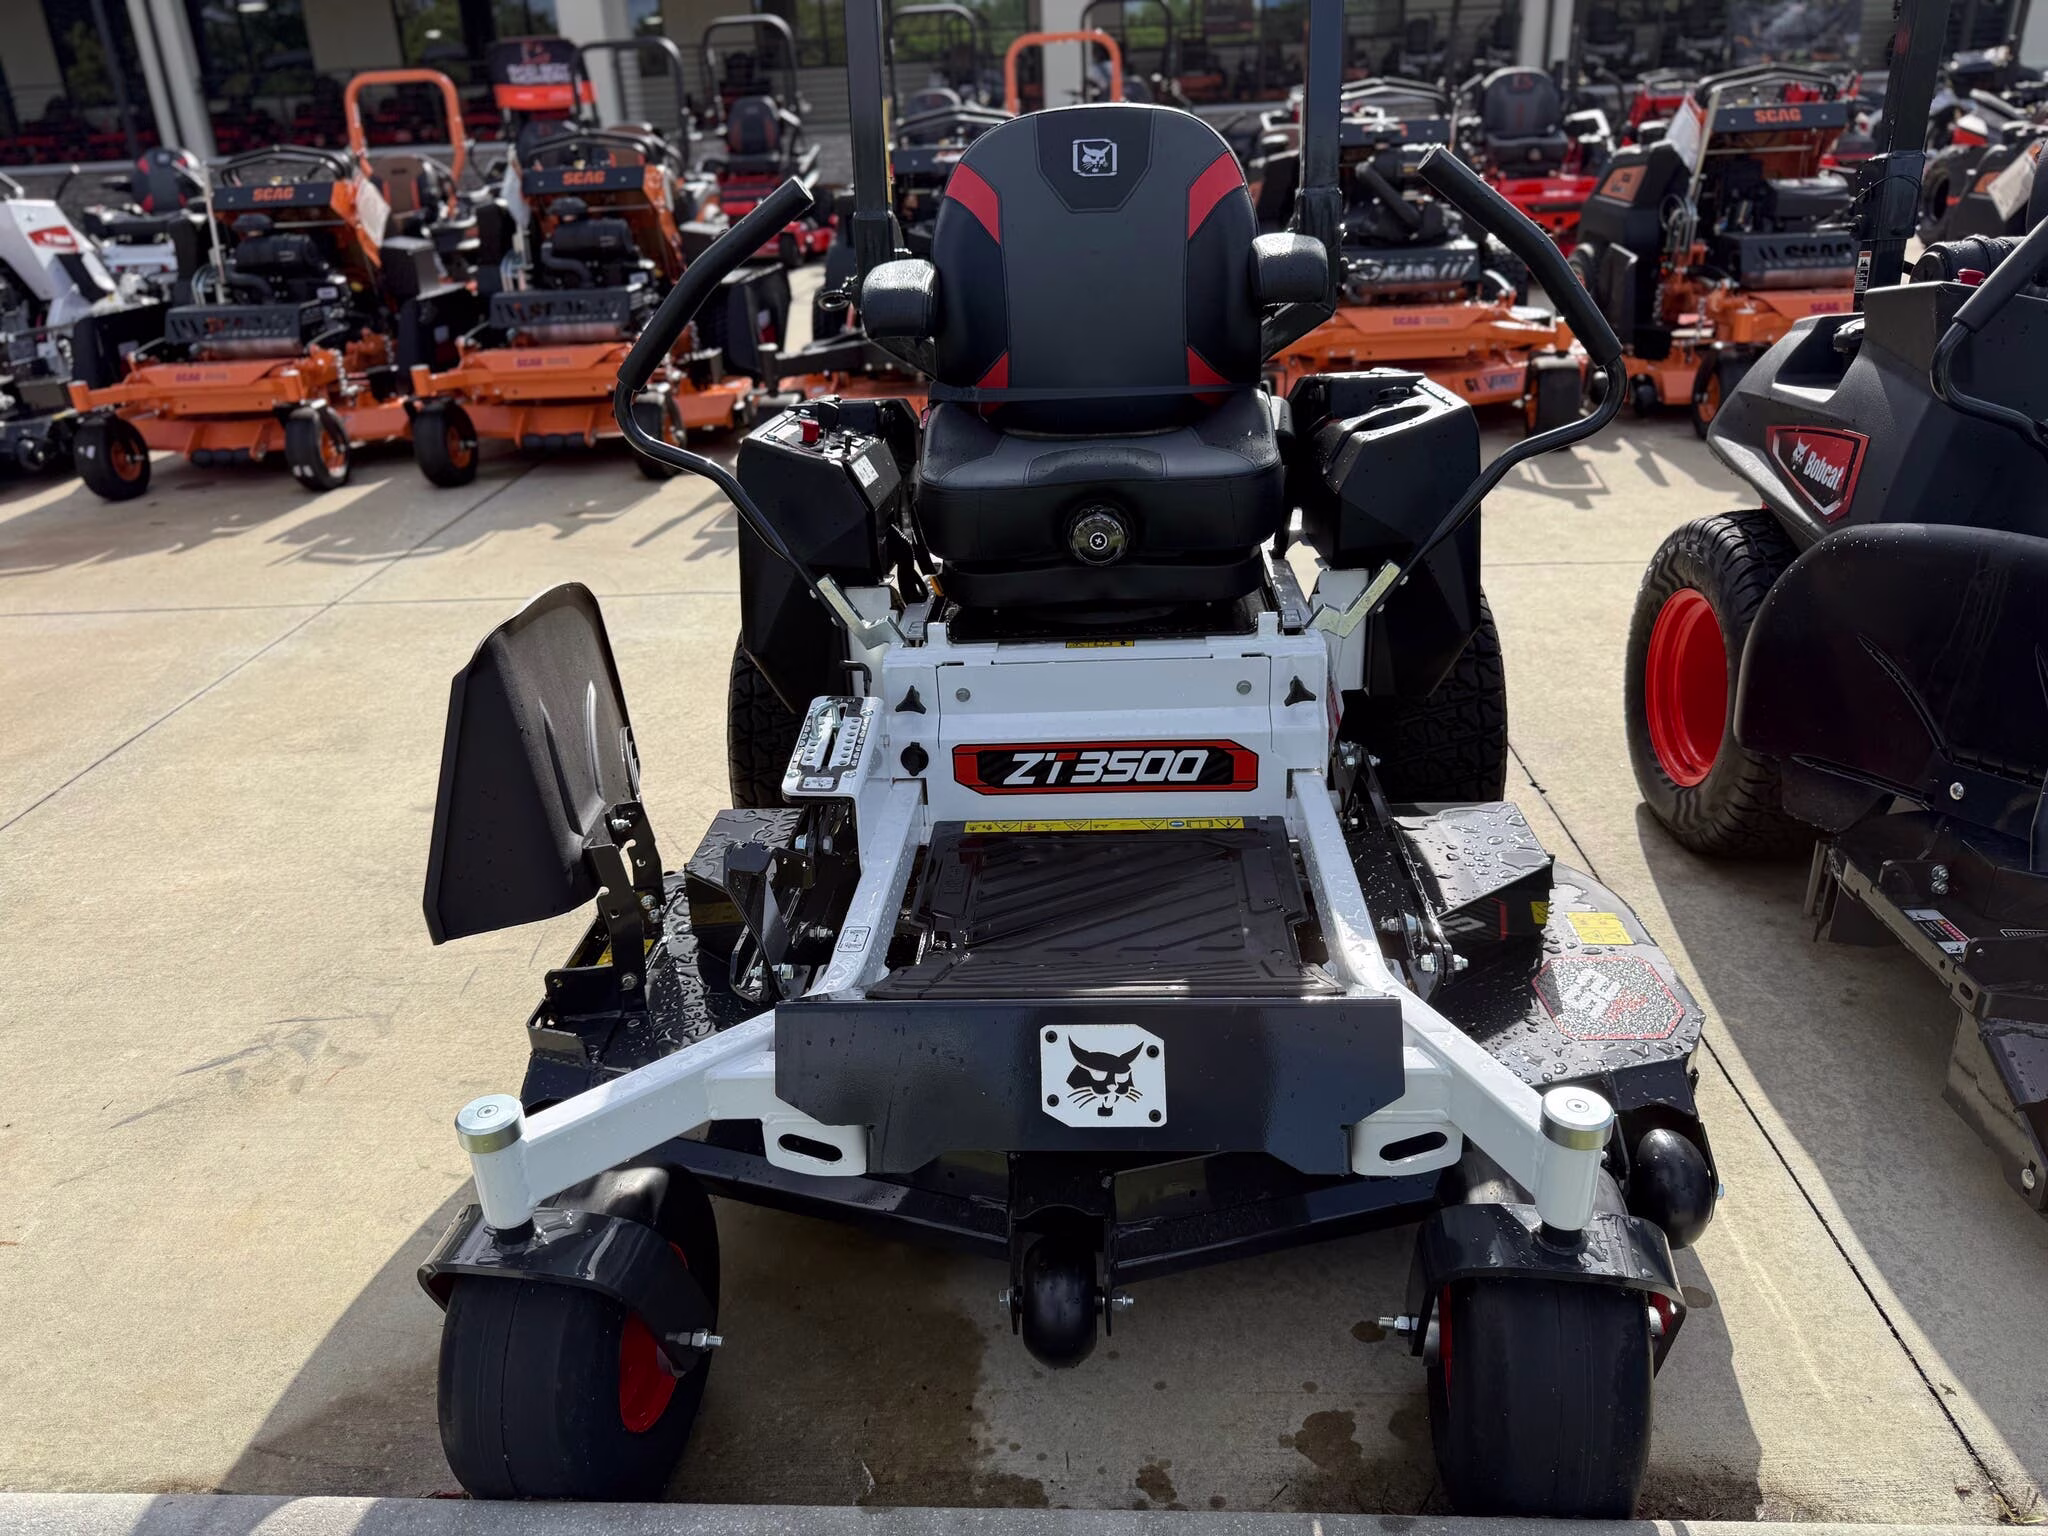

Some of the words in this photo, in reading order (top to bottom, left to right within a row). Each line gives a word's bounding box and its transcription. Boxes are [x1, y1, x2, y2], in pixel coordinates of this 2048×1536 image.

[1754, 108, 1802, 123] SCAG
[562, 170, 605, 185] SCAG
[253, 186, 294, 201] SCAG
[1810, 302, 1840, 313] SCAG
[1803, 451, 1845, 491] Bobcat
[1003, 750, 1209, 785] ZT3500
